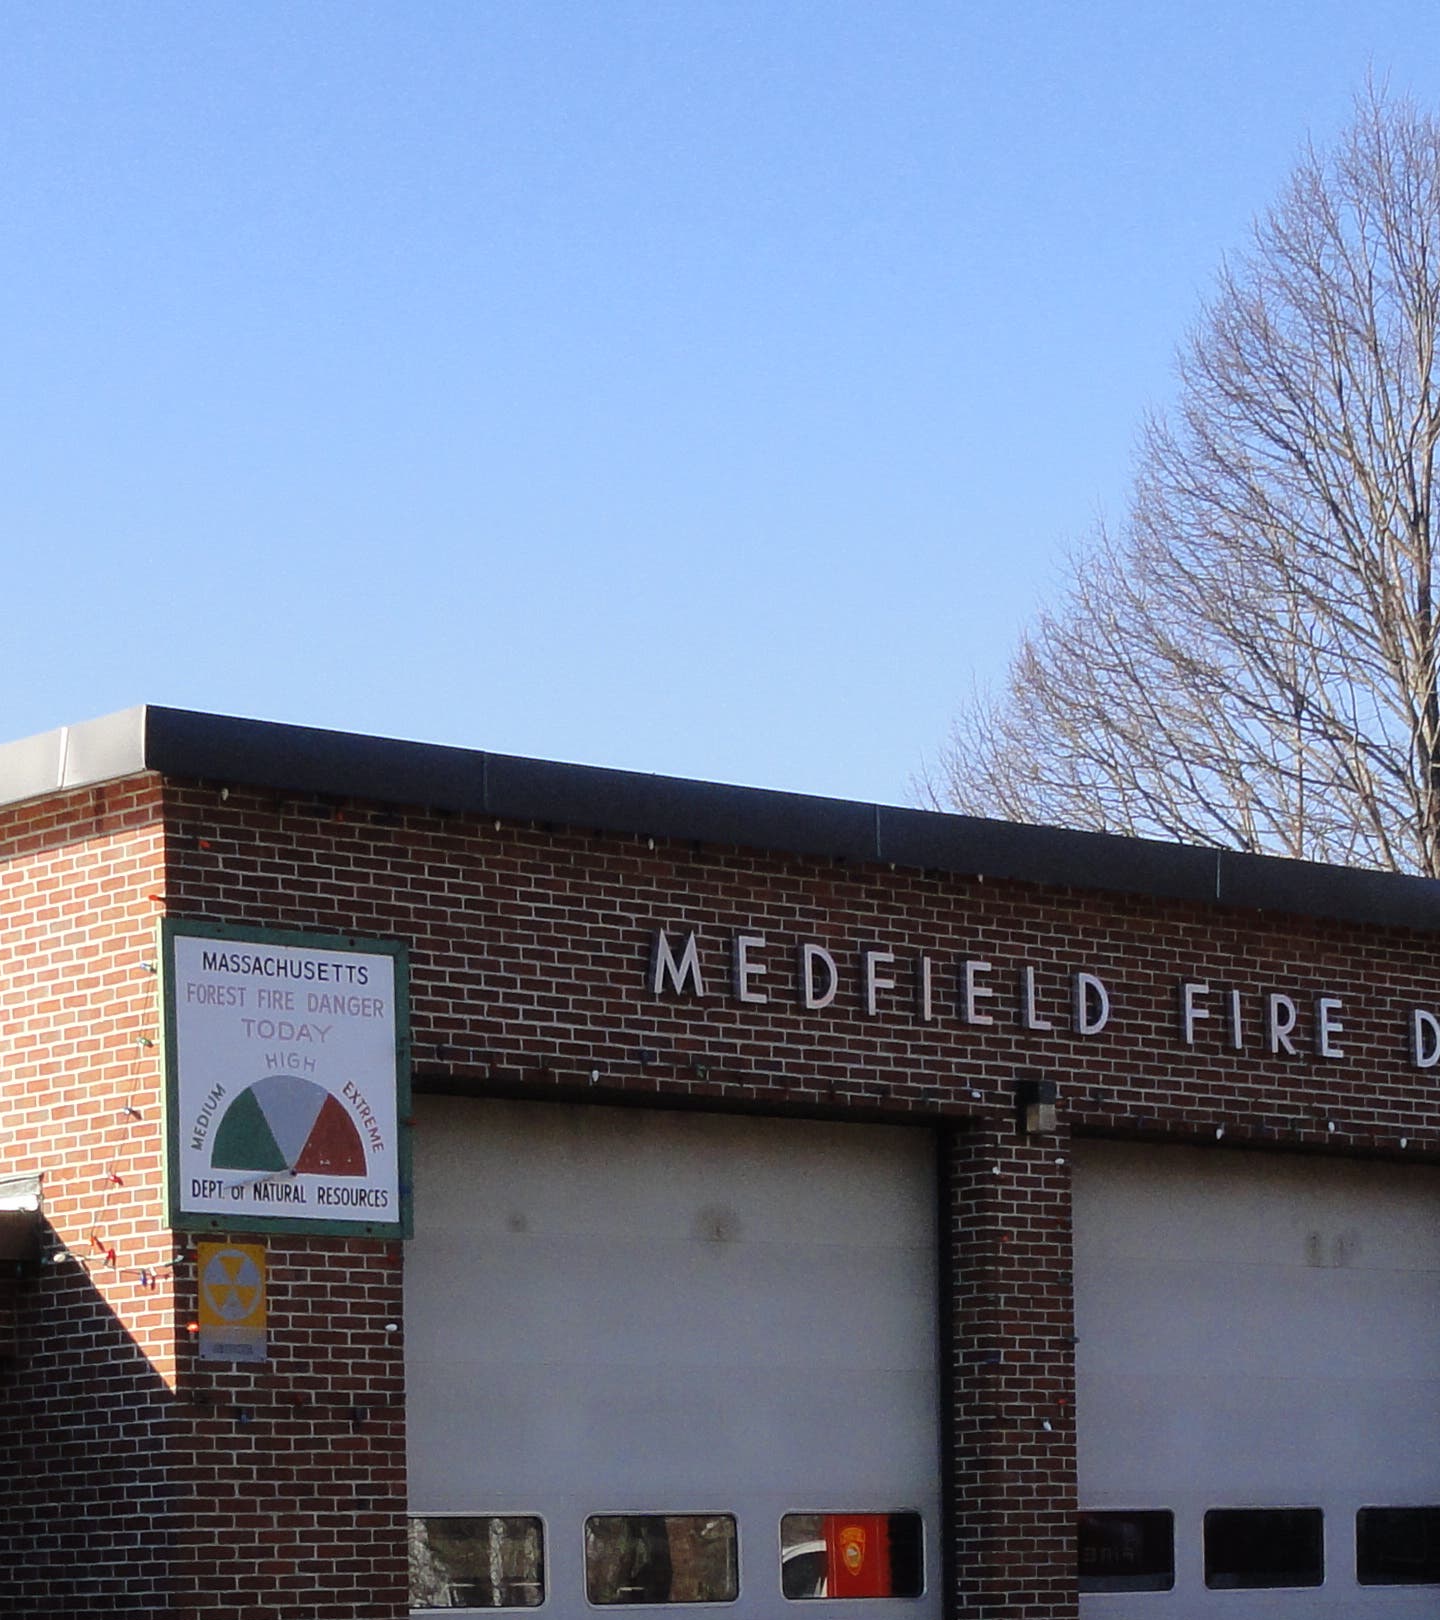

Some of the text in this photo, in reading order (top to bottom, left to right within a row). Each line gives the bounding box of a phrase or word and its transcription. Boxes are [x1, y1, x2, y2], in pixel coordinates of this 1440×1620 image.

[203, 952, 368, 985] MASSACHUSETTS
[187, 983, 384, 1018] FOREST FIRE DANGER
[651, 928, 1109, 1035] MEDFIELD
[1179, 983, 1345, 1058] FIRE
[241, 1018, 333, 1043] TODAY
[265, 1052, 317, 1072] HIGH
[191, 1083, 227, 1151] MEDIUM
[342, 1081, 384, 1154] EXTREME
[192, 1179, 225, 1199] DEPT.
[253, 1182, 307, 1204] NATURAL
[317, 1186, 388, 1208] RESOURCES
